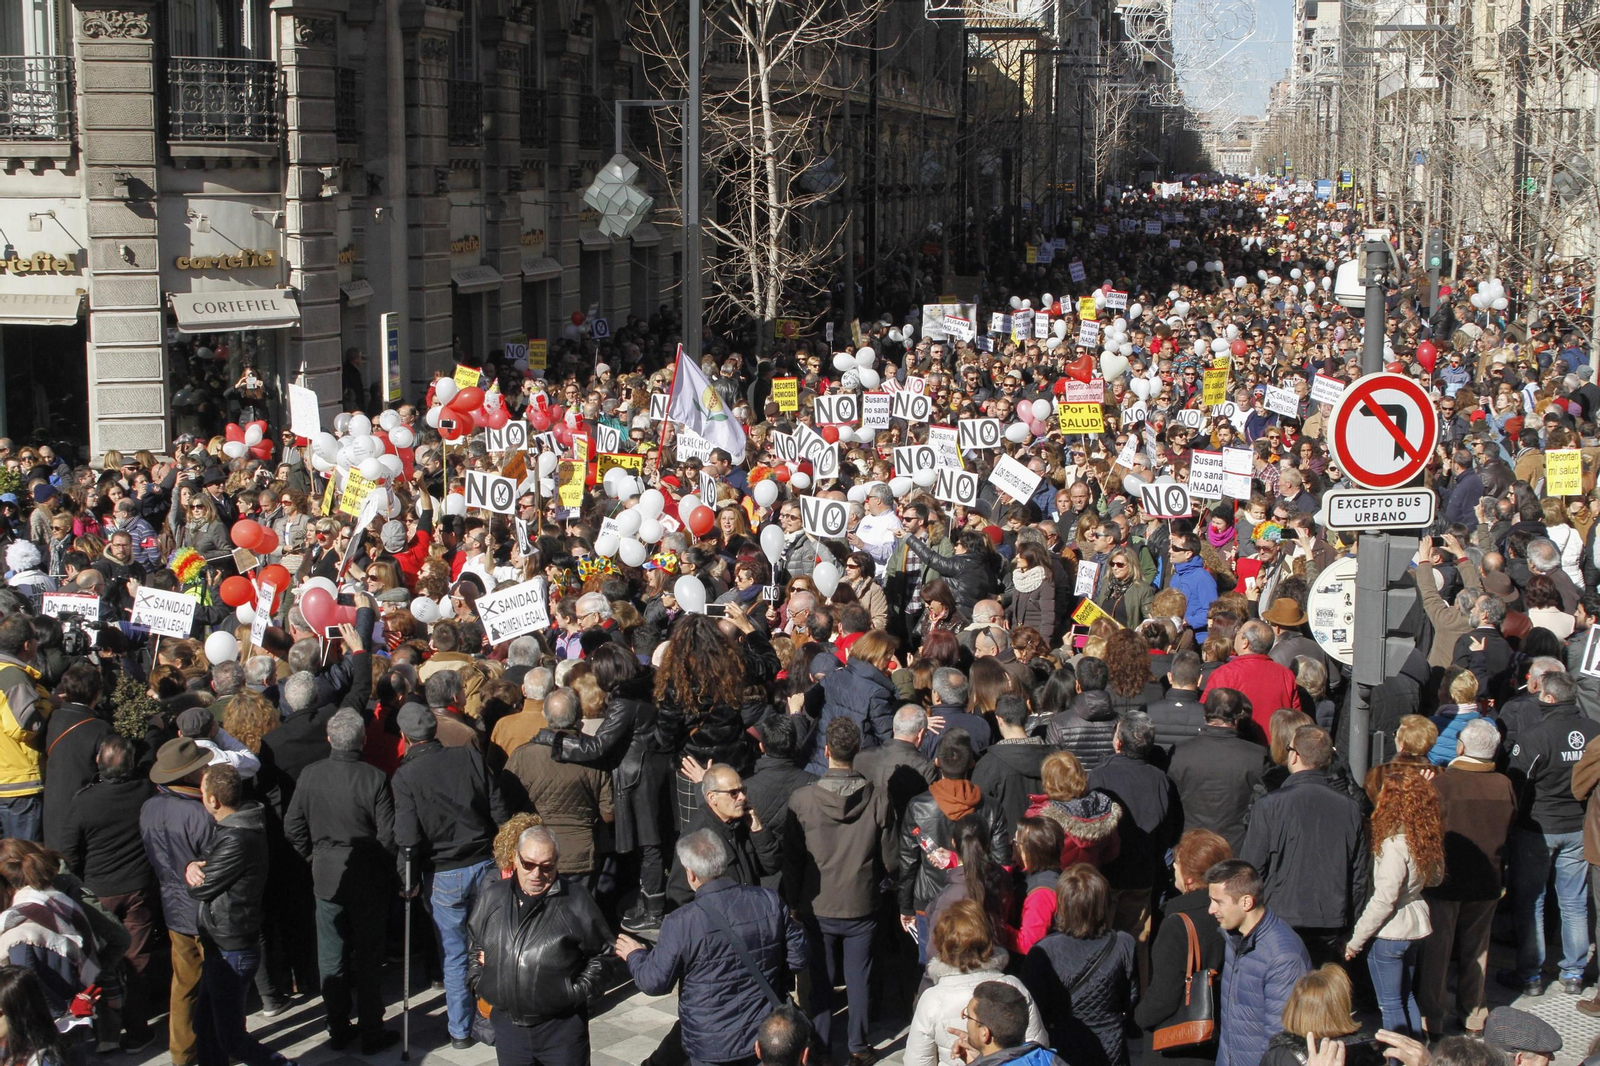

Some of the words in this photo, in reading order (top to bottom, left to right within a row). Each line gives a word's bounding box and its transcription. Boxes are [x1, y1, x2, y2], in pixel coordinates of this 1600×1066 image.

[175, 249, 278, 271] cortefiel
[192, 299, 280, 315] CORTEFIEL
[506, 344, 526, 358] NO
[774, 382, 796, 390] RECORTES
[775, 390, 797, 398] HOMICIDAS
[651, 395, 667, 420] N
[816, 396, 856, 425] NO
[895, 392, 929, 420] NO
[1059, 404, 1084, 416] ¡Por
[1088, 404, 1099, 414] la
[1061, 418, 1102, 428] SALUD!
[1125, 409, 1146, 423] NO
[485, 422, 527, 450] NO
[597, 426, 618, 454] NO
[960, 420, 999, 446] NO
[679, 436, 711, 451] DERECHO
[775, 433, 797, 463] NO
[629, 457, 641, 467] la
[896, 446, 936, 475] NO
[1192, 470, 1202, 478] no
[1204, 472, 1223, 481] sana
[1548, 466, 1558, 475] mi
[1559, 465, 1579, 475] salud
[467, 472, 514, 511] NO
[700, 471, 716, 508] NO
[937, 468, 975, 503] NO
[1190, 481, 1222, 494] ¡NADA!
[1549, 482, 1554, 491] y
[1555, 479, 1562, 488] mi
[1141, 485, 1189, 516] NO
[1337, 498, 1393, 509] EXCEPTO
[1397, 497, 1421, 507] BUS
[802, 497, 847, 536] NO
[1355, 511, 1407, 522] URBANO
[31, 582, 46, 594] DOS
[765, 587, 779, 600] NO
[145, 614, 170, 629] CRIMEN
[499, 612, 523, 635] CRIMEN
[521, 607, 547, 627] LEGAL!
[1561, 750, 1585, 762] YAMA
